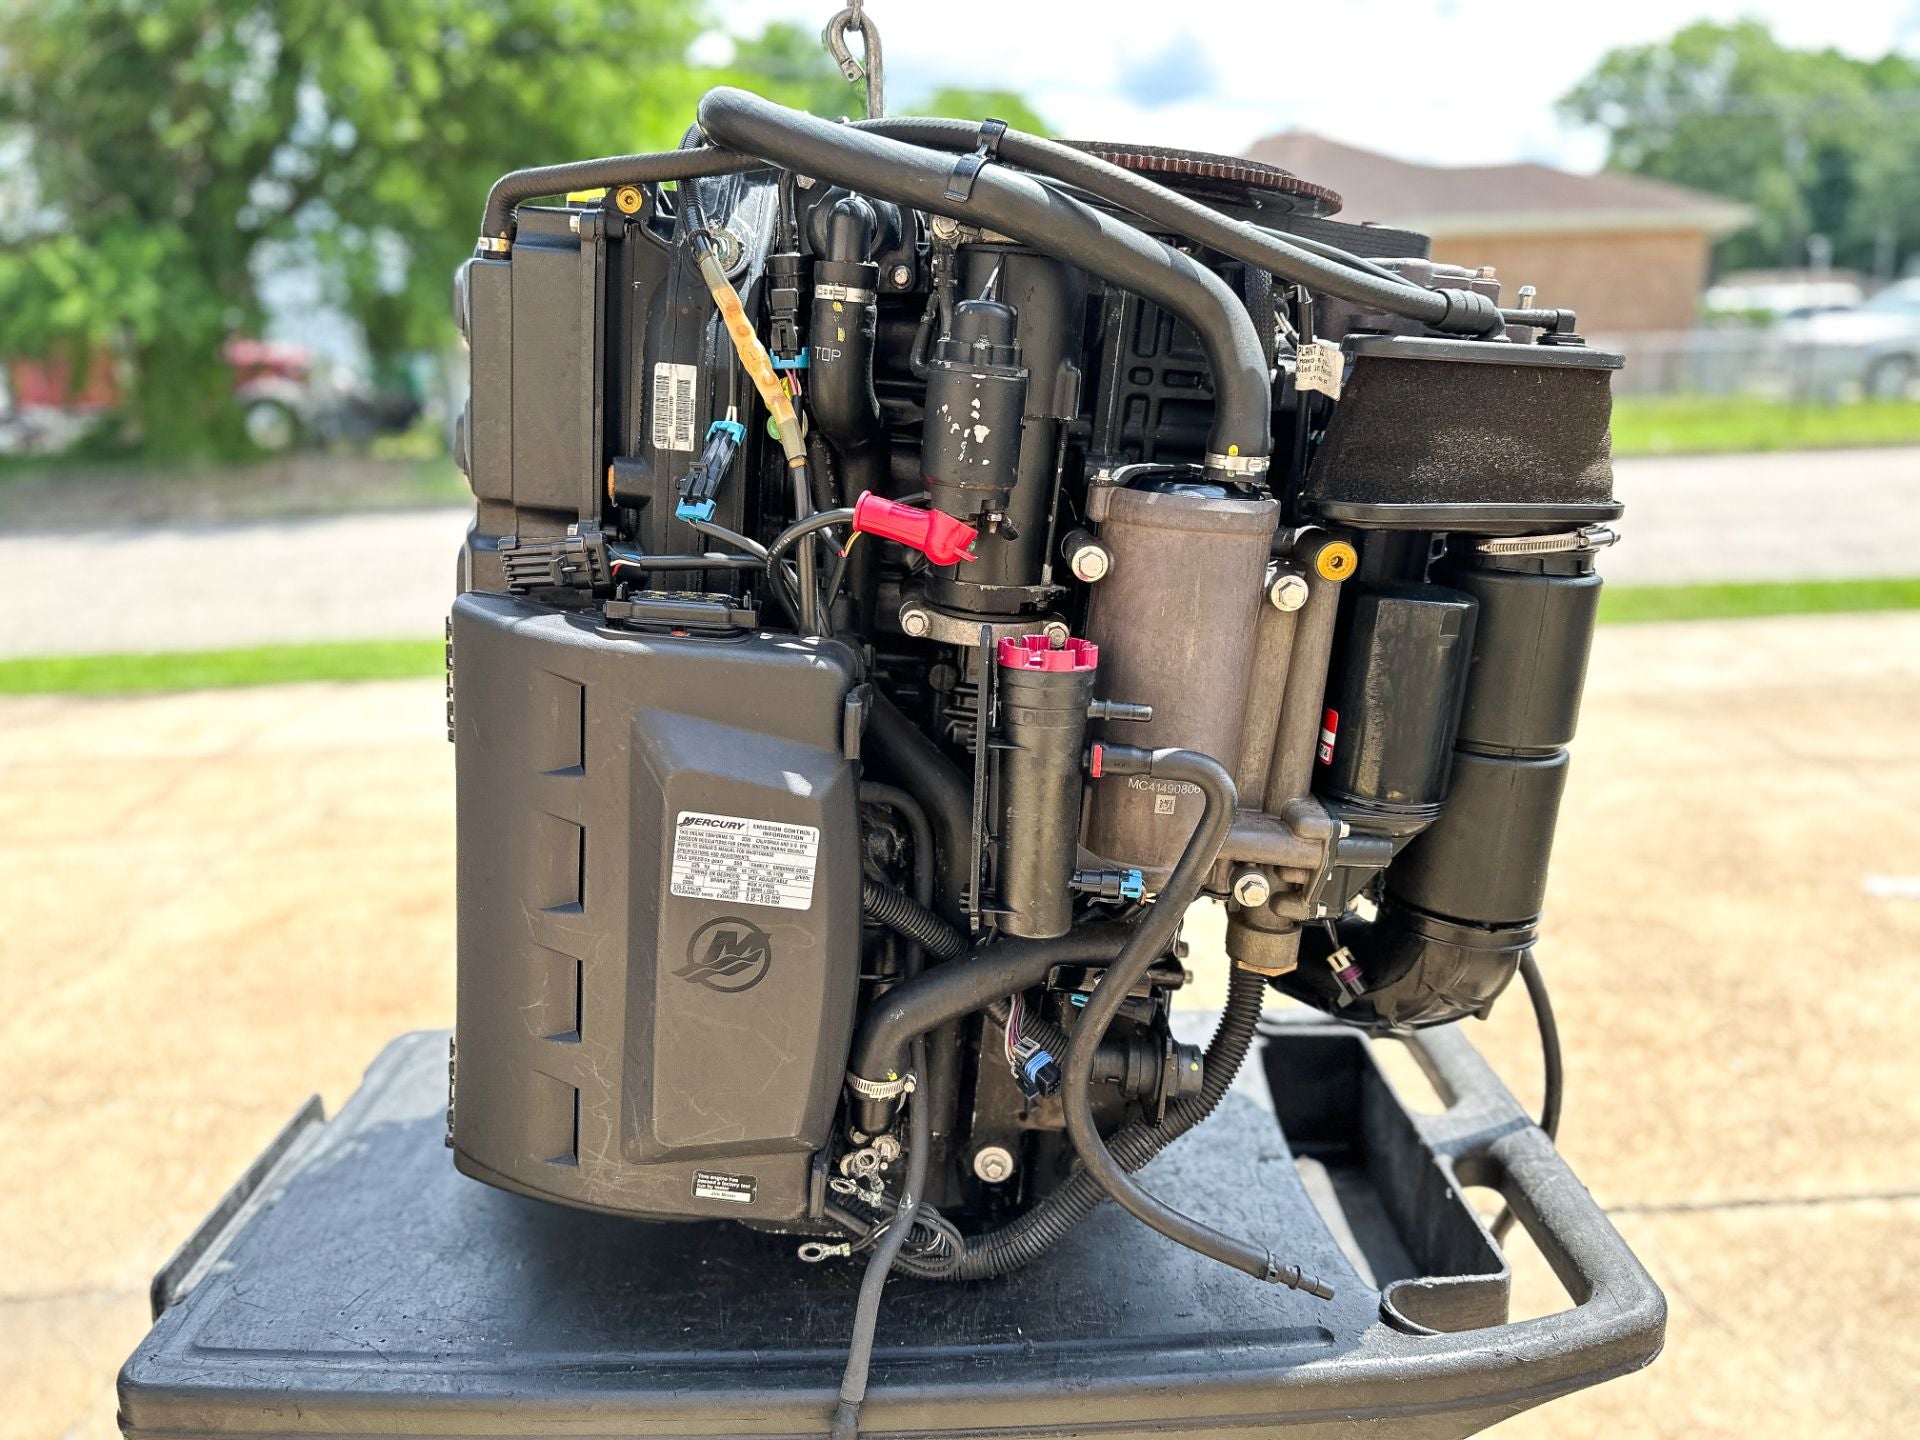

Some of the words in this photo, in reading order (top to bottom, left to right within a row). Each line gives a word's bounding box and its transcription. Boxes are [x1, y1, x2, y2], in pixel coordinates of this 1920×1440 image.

[815, 346, 841, 362] TOP
[678, 816, 745, 830] MERCURY
[762, 831, 803, 840] INFORMATION
[783, 827, 810, 835] CONTROL
[722, 1181, 740, 1189] factory
